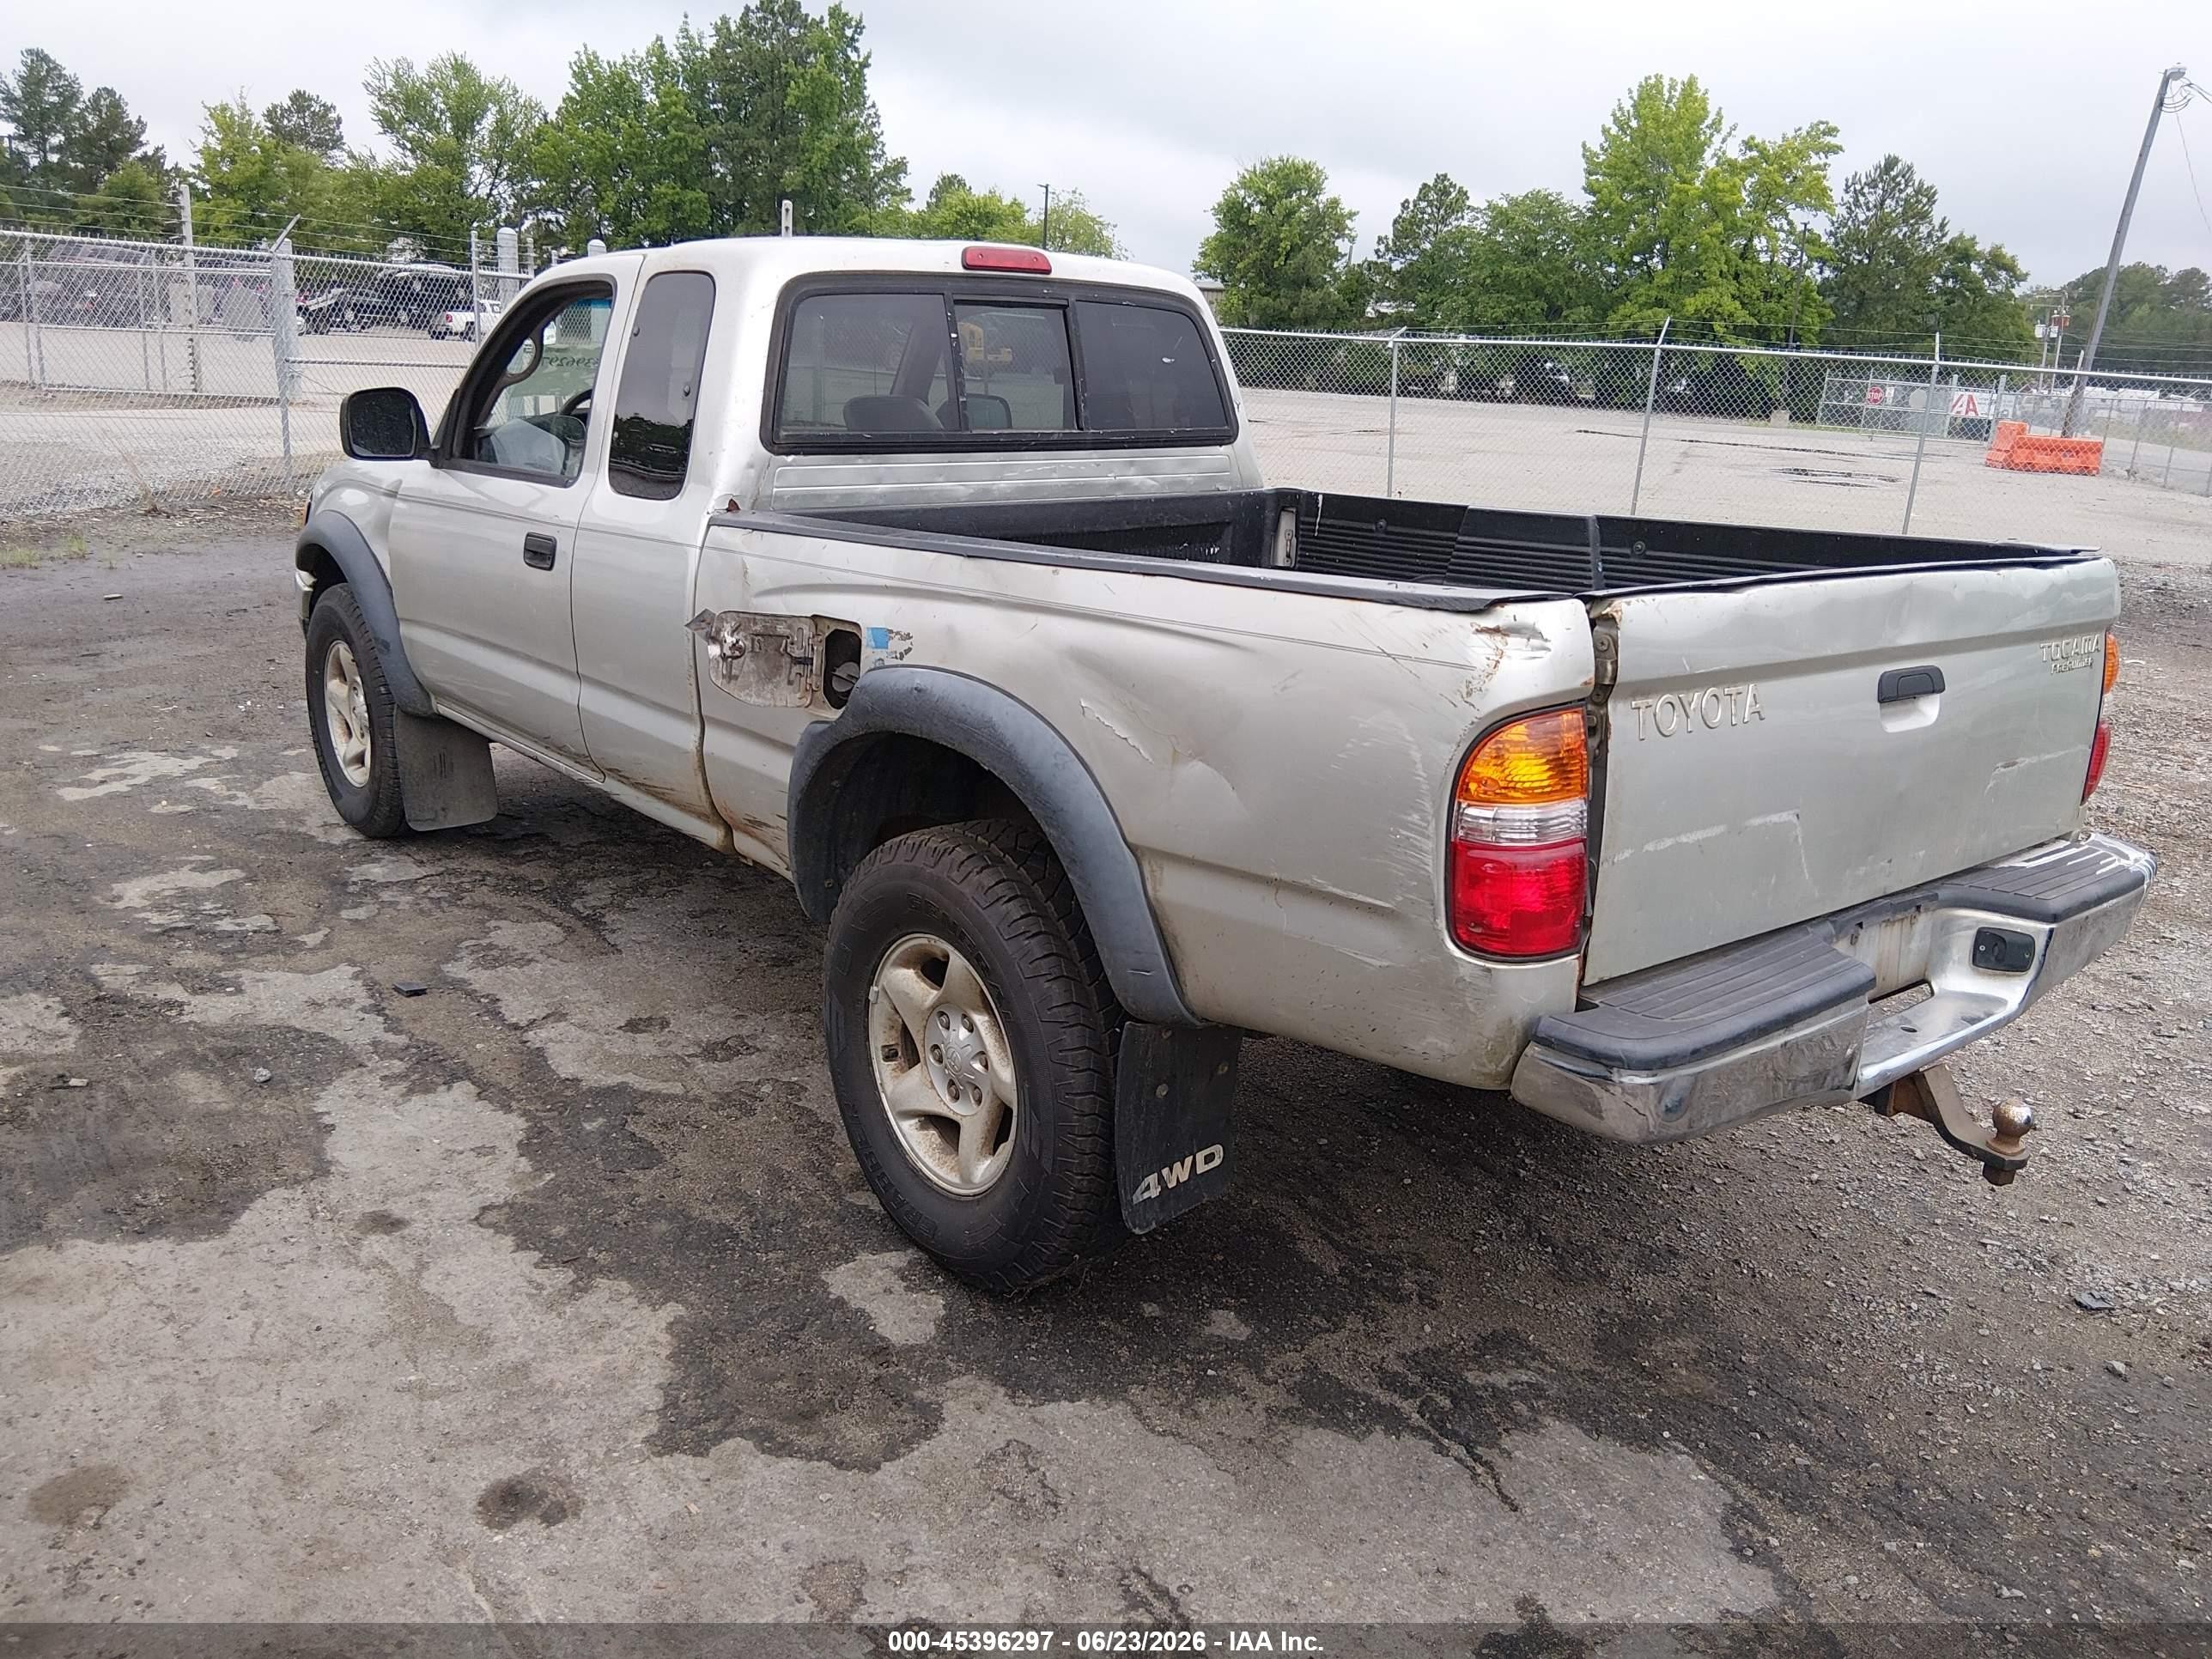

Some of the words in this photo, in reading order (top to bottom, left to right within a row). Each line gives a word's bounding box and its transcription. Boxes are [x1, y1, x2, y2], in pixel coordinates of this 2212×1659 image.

[1867, 392, 1883, 401] STOP
[1632, 684, 1765, 741] TOYOTA
[1132, 1143, 1224, 1206] 4WD
